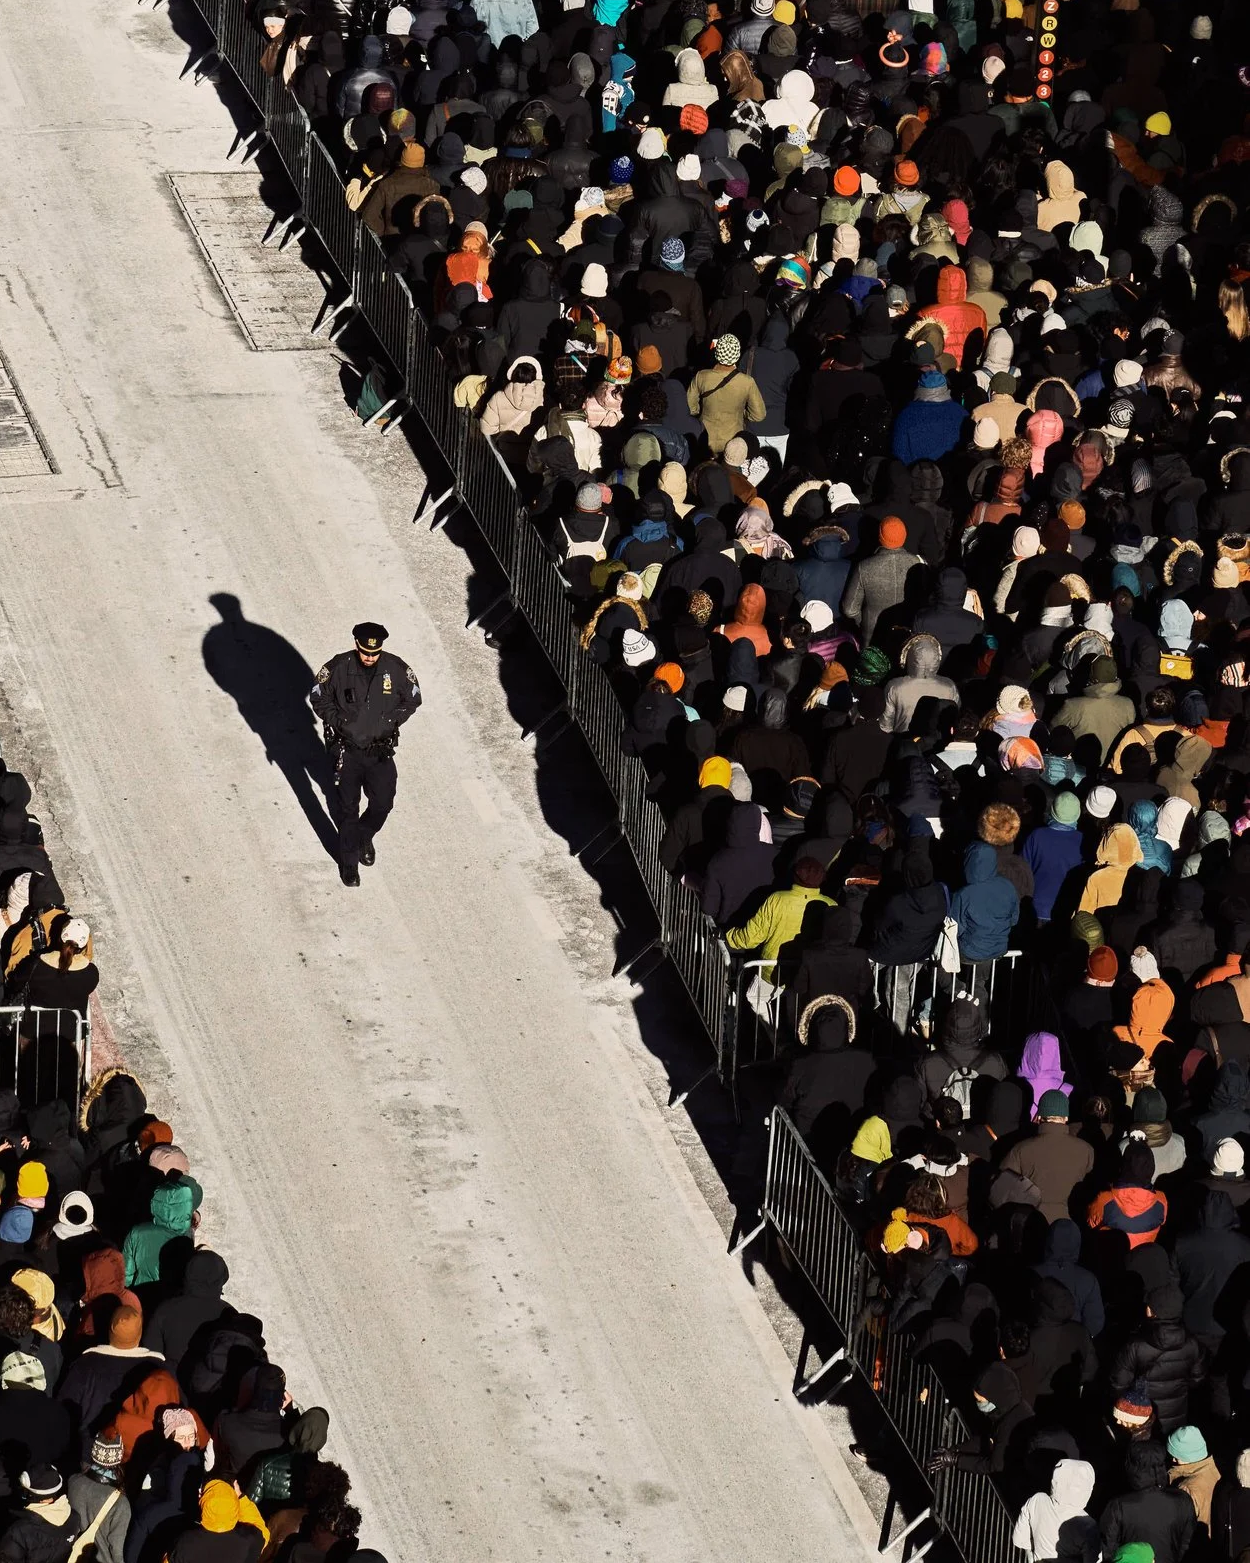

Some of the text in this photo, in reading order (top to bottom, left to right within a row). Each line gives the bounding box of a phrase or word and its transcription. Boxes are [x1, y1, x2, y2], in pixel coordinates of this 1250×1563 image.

[1047, 2, 1055, 11] Z
[1046, 19, 1053, 28] R
[1043, 37, 1053, 45] W
[1044, 53, 1049, 62] 1
[1042, 70, 1049, 79] 2
[1040, 87, 1047, 96] 3
